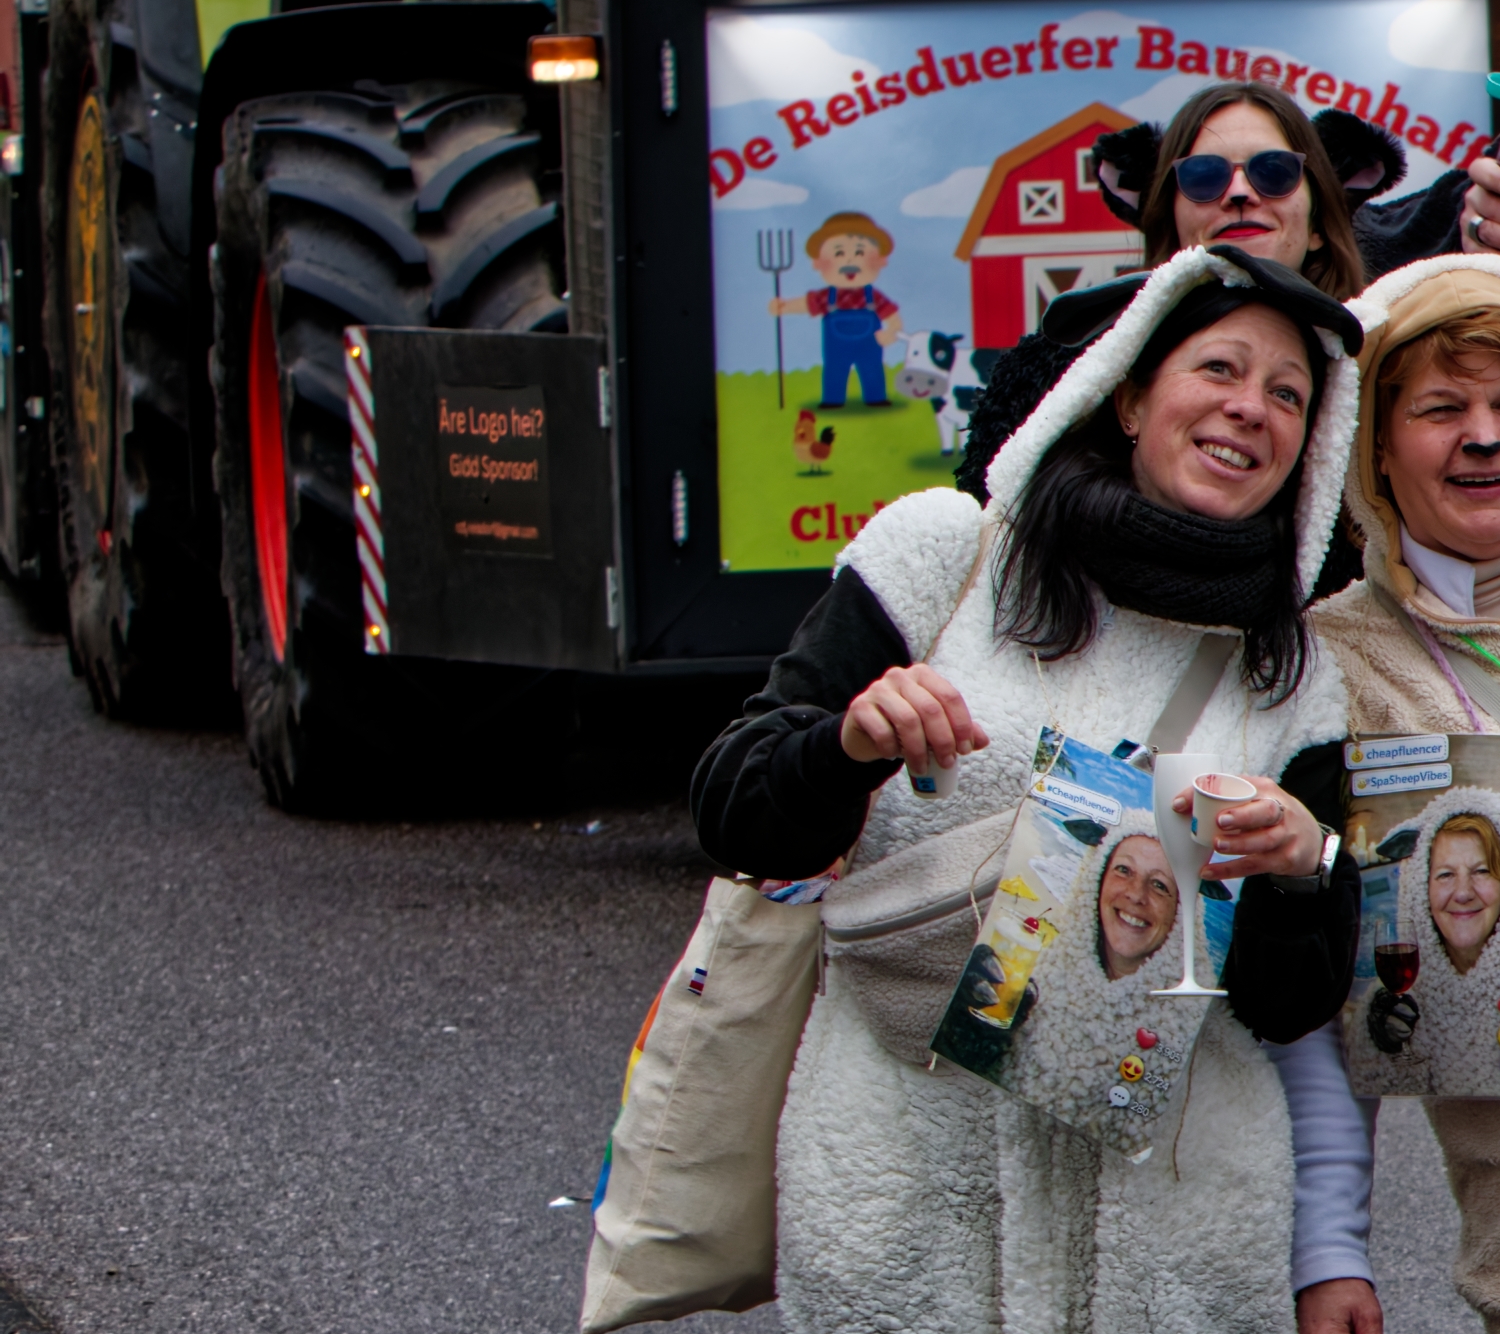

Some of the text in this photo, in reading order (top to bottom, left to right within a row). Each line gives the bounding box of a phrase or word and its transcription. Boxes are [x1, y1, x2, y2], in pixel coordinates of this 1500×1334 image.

[707, 22, 1494, 200] De Reisduerfer Bauerenhaff
[468, 406, 508, 443] Logo
[789, 500, 887, 542] Clu
[1131, 1100, 1151, 1118] 280
